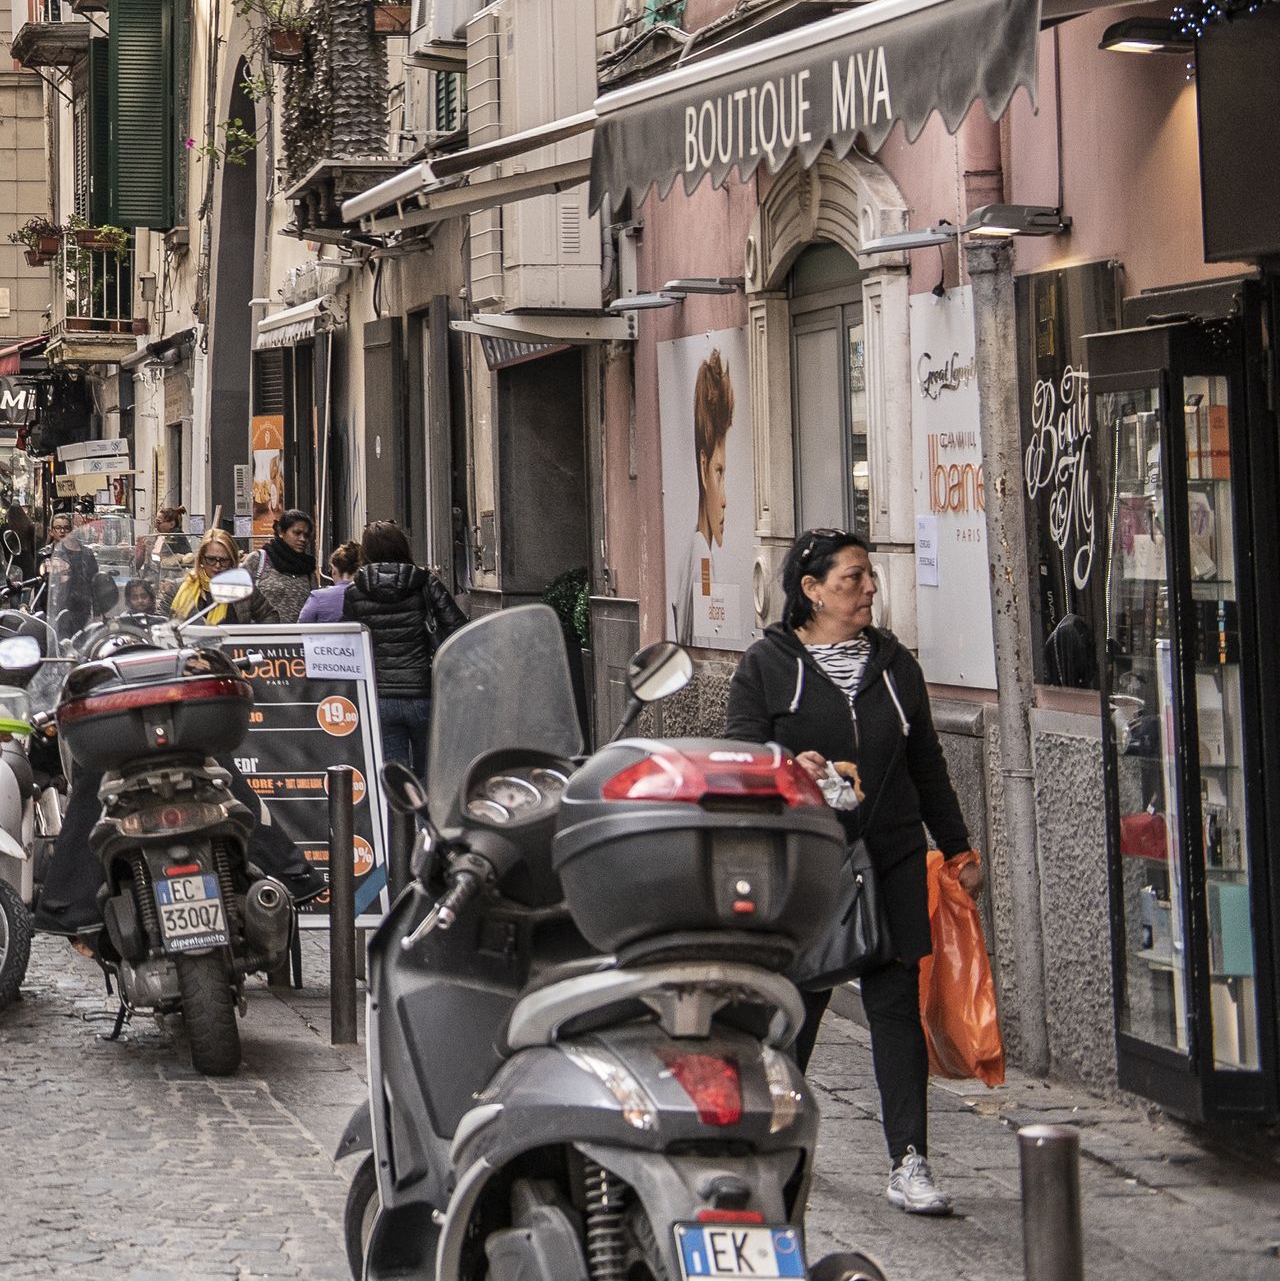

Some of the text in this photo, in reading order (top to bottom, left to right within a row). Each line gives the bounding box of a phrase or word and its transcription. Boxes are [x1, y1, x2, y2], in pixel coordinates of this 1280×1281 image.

[685, 46, 892, 173] BOUTIQUE MYA
[940, 432, 977, 449] CAMILL
[956, 528, 981, 542] PARIS
[313, 646, 355, 657] CERCASI
[312, 663, 361, 674] PERSONALE
[321, 702, 357, 723] 19.00
[171, 879, 195, 901] EC
[163, 904, 220, 931] 33007
[709, 1232, 756, 1273] EK
